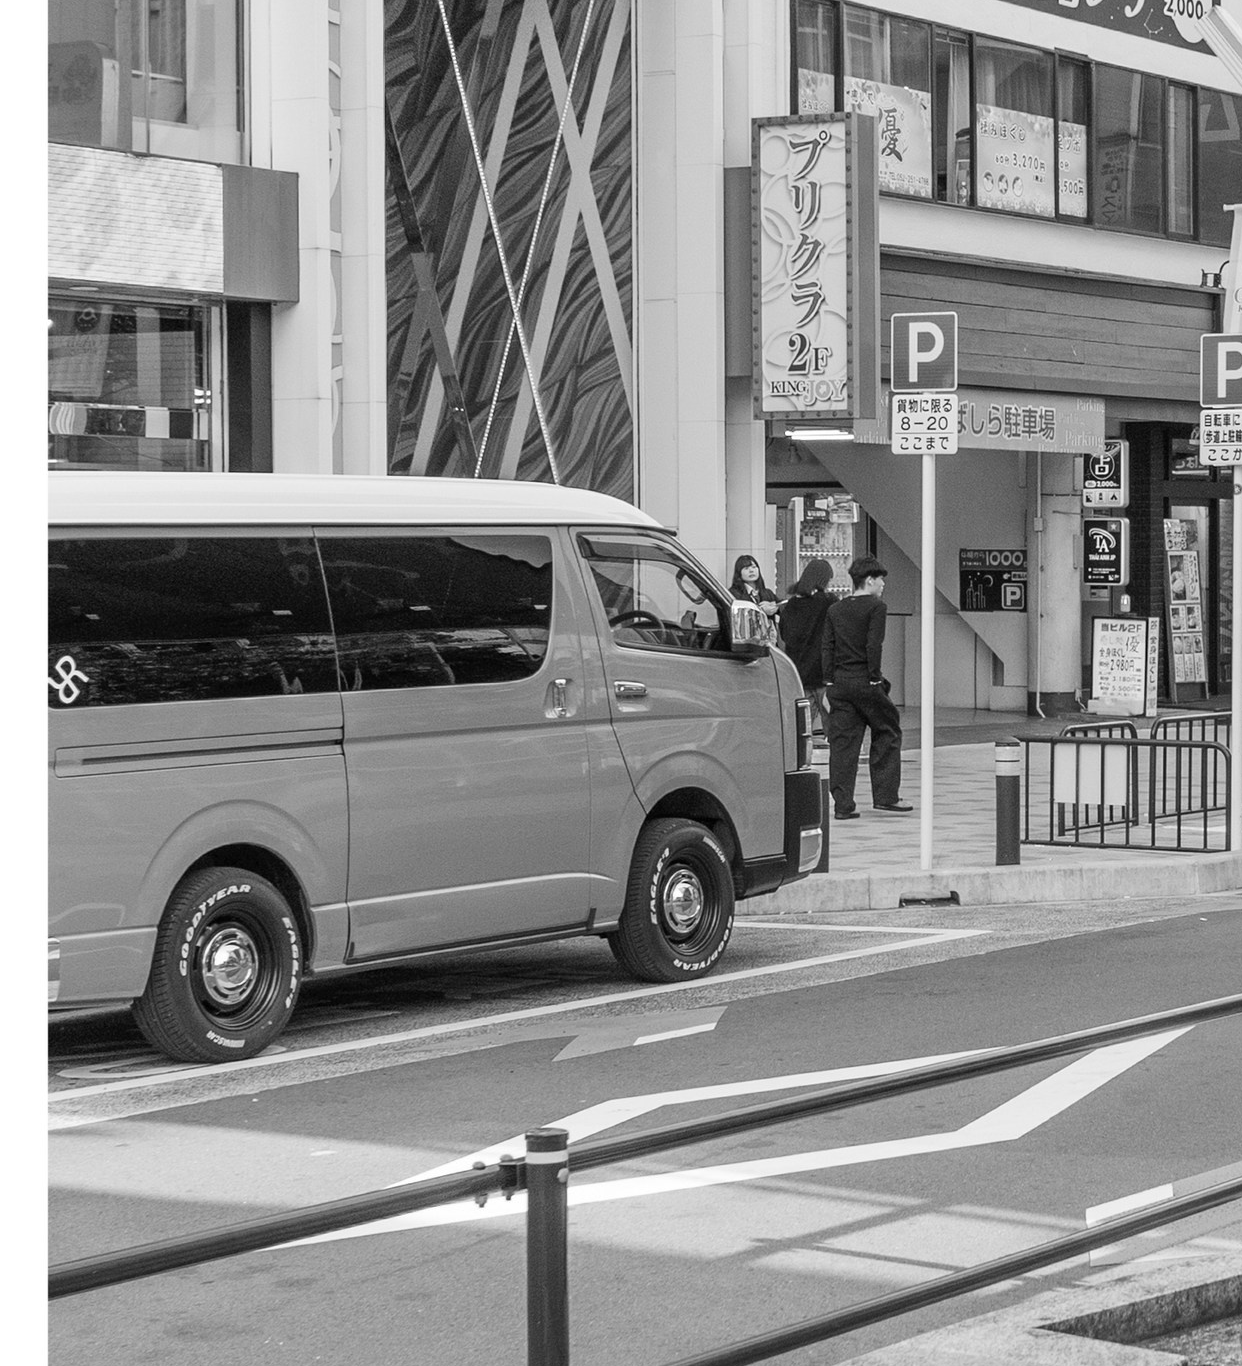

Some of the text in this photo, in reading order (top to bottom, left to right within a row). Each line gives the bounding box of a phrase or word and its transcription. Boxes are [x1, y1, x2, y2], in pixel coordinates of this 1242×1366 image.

[789, 130, 831, 330] プリクラ
[787, 332, 832, 376] 2F
[907, 321, 944, 383] P
[771, 378, 845, 406] KING JOY
[897, 398, 952, 413] 貨物に限る
[901, 416, 948, 431] 8-20
[900, 436, 949, 451] ここまで
[986, 551, 1023, 566] 1000
[1006, 586, 1021, 606] P
